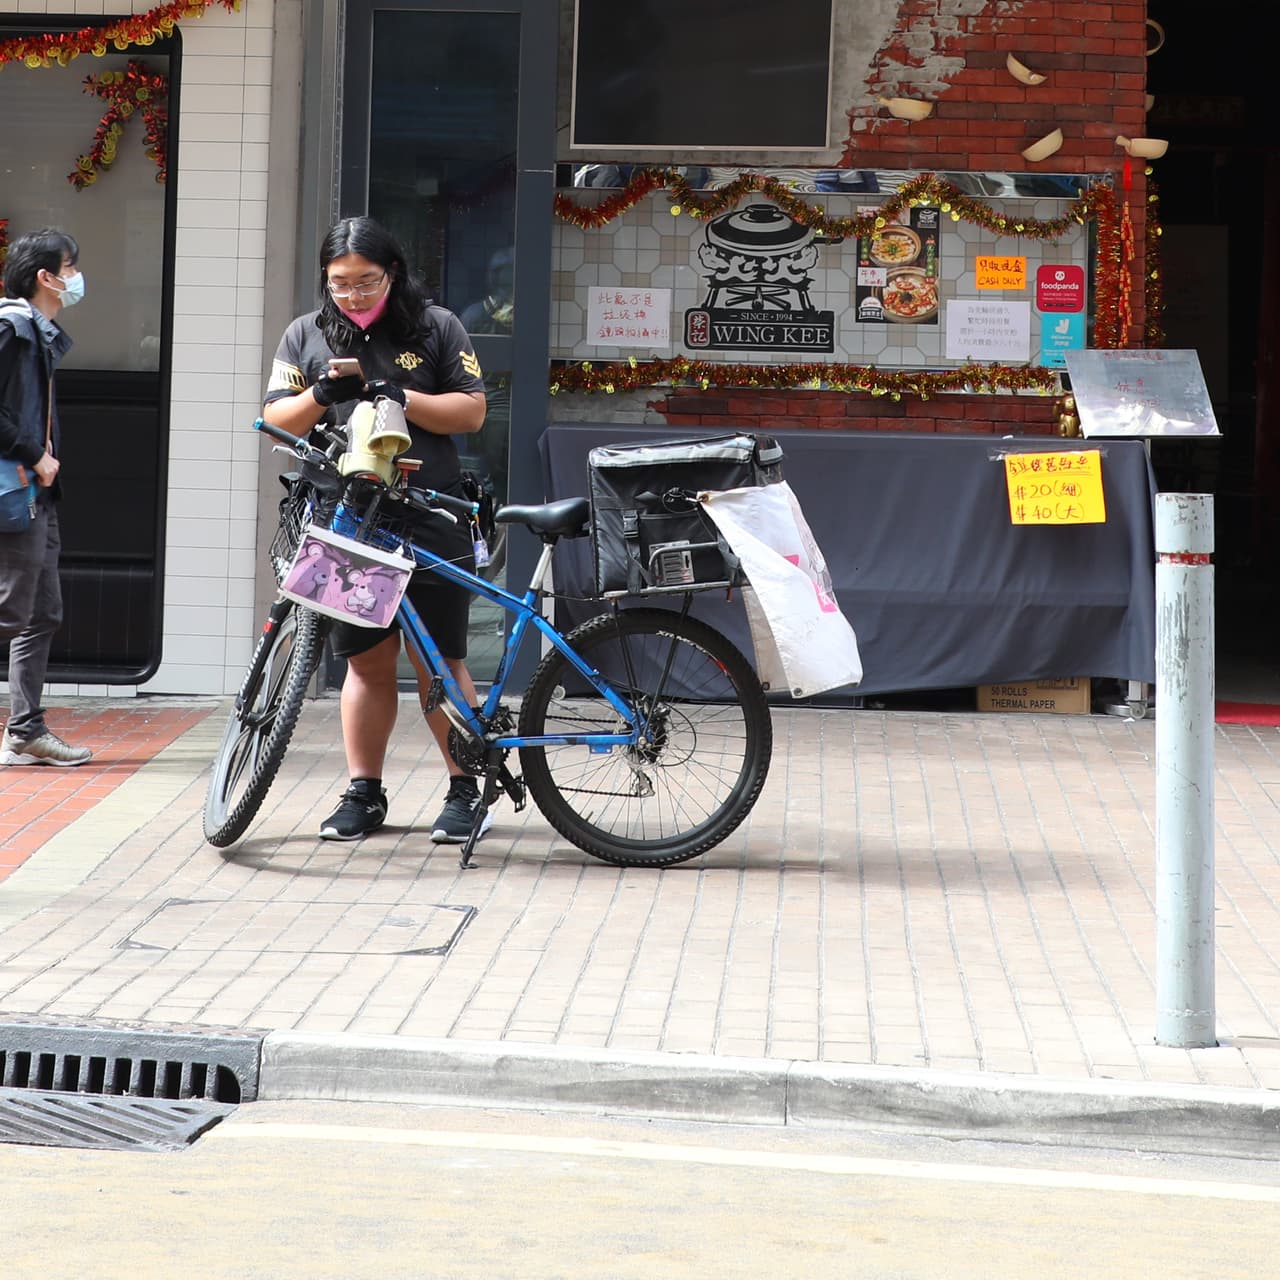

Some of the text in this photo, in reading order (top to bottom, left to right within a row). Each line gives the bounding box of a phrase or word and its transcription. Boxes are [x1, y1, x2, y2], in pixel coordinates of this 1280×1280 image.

[978, 277, 999, 286] CASH
[1041, 282, 1080, 291] foodpanda
[741, 312, 793, 321] SINCE 1994
[713, 326, 831, 345] WING KEE
[1001, 687, 1028, 697] ROLLS
[991, 699, 1056, 709] THERMAL PAPER
